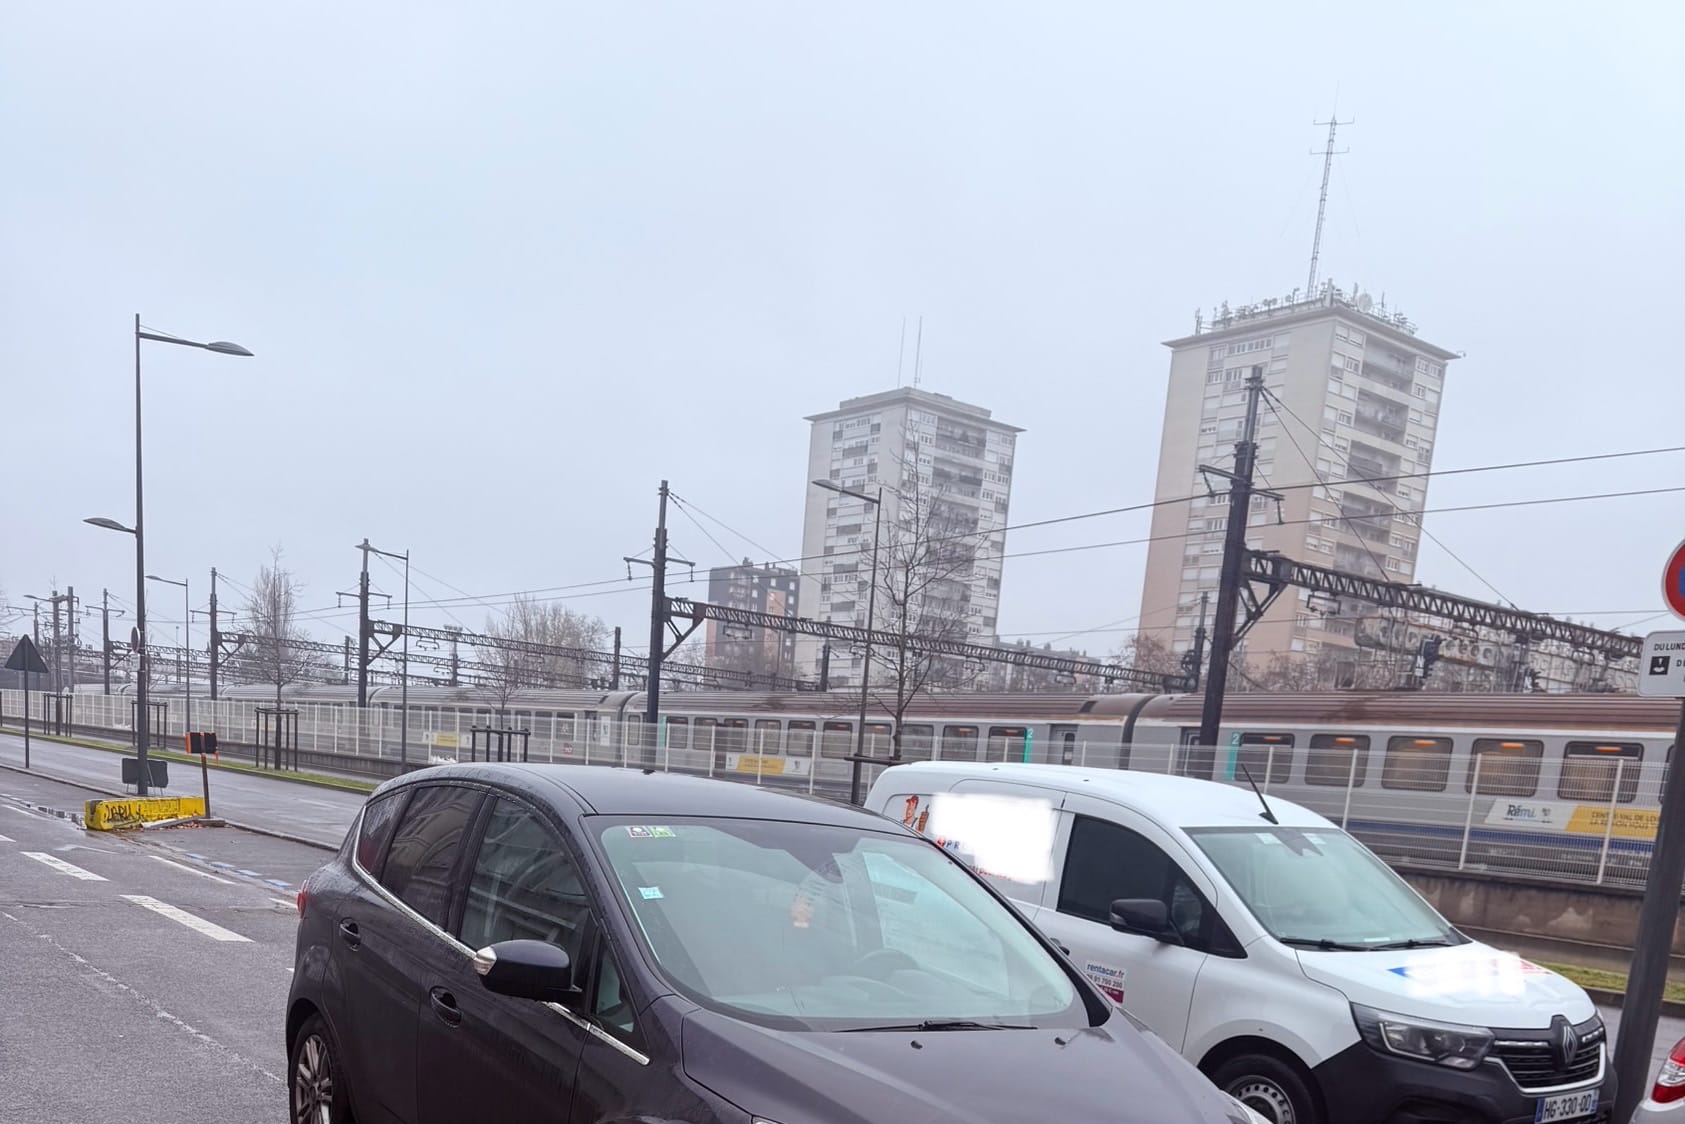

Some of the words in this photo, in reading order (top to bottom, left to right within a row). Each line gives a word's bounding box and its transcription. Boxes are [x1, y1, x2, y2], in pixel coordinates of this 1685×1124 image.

[1654, 642, 1665, 651] DU
[1232, 732, 1240, 745] 2
[1506, 804, 1537, 818] Rémi
[1087, 963, 1124, 979] rentacar.fr
